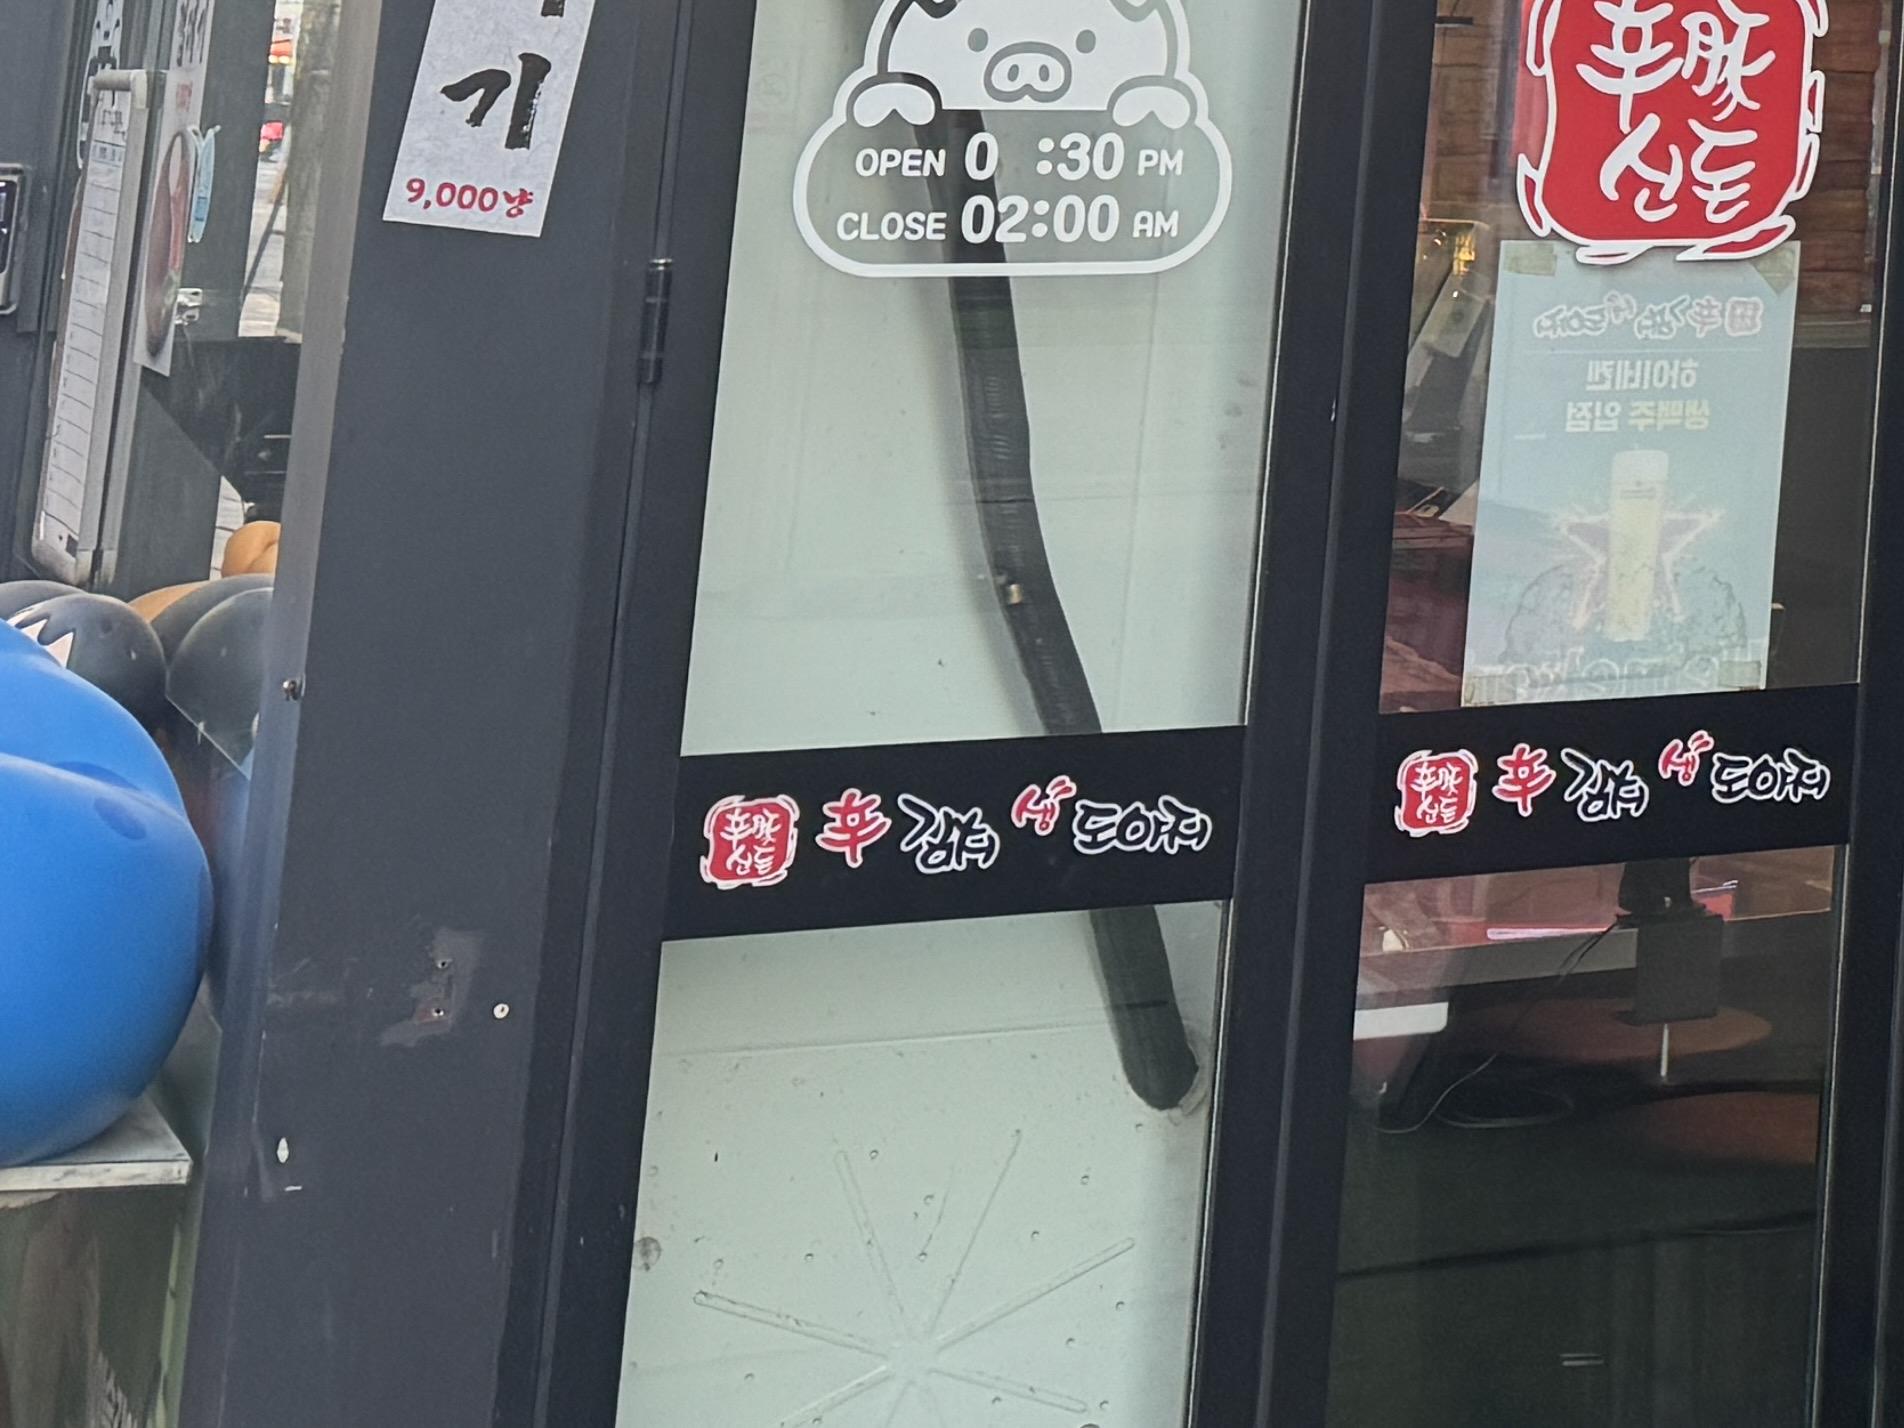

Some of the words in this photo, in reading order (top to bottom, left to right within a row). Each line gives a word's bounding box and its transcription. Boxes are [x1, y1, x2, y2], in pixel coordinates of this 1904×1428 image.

[855, 147, 947, 177] OPEN
[1137, 149, 1184, 177] PM
[405, 177, 534, 217] 9,000냥
[837, 211, 948, 241] CLOSE
[961, 194, 1121, 244] 02:00
[1132, 210, 1179, 238] AM
